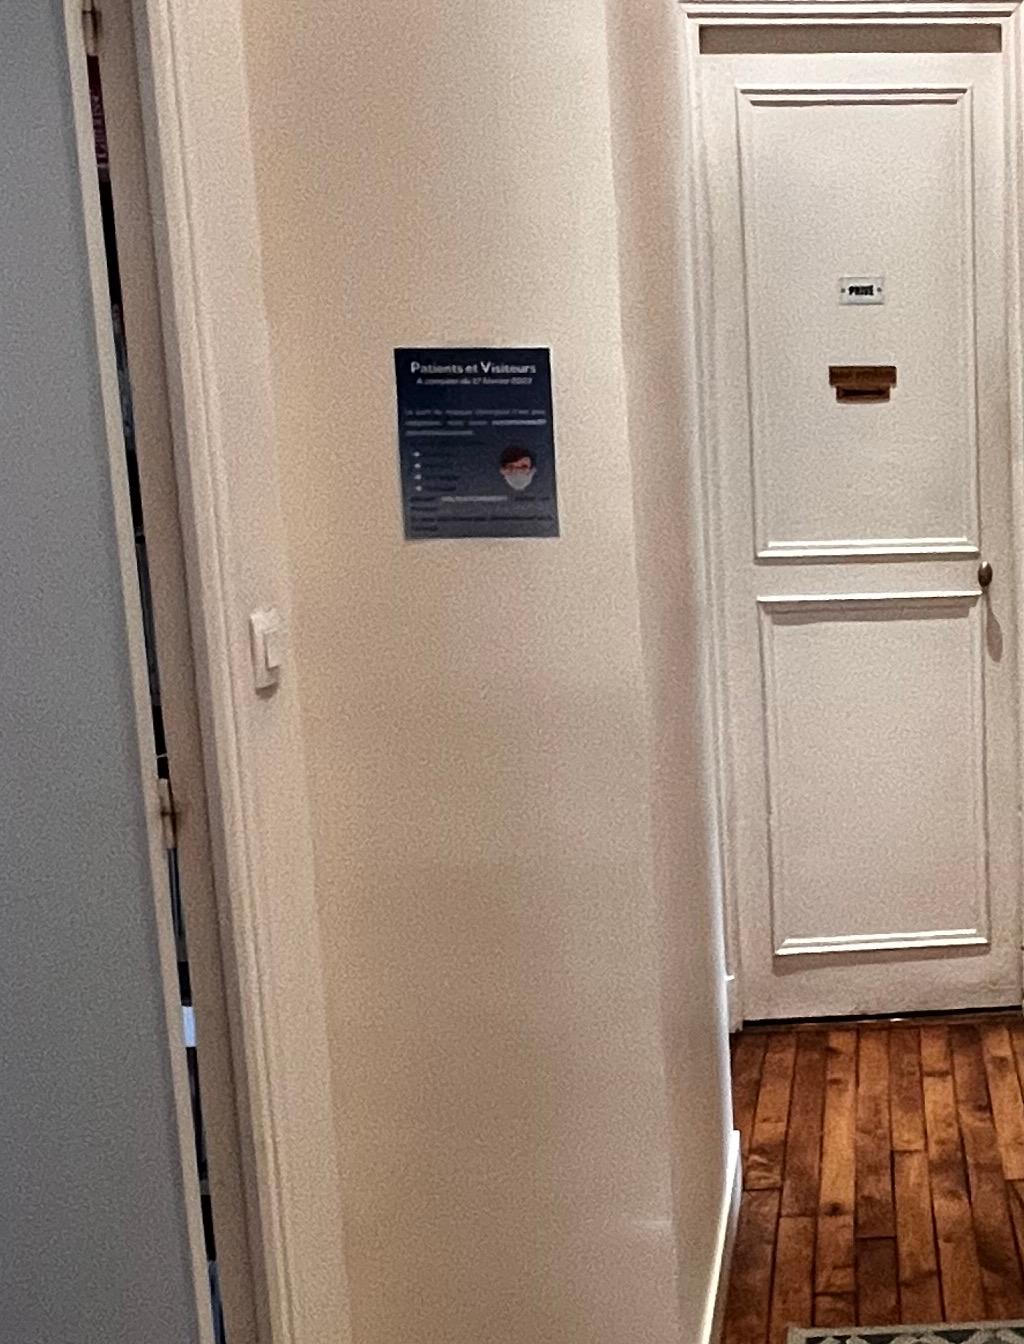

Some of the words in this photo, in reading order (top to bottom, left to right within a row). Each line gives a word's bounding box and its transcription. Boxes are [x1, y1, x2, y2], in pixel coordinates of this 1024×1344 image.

[410, 361, 464, 374] Patients
[465, 364, 478, 374] et
[480, 361, 536, 374] Visiteurs
